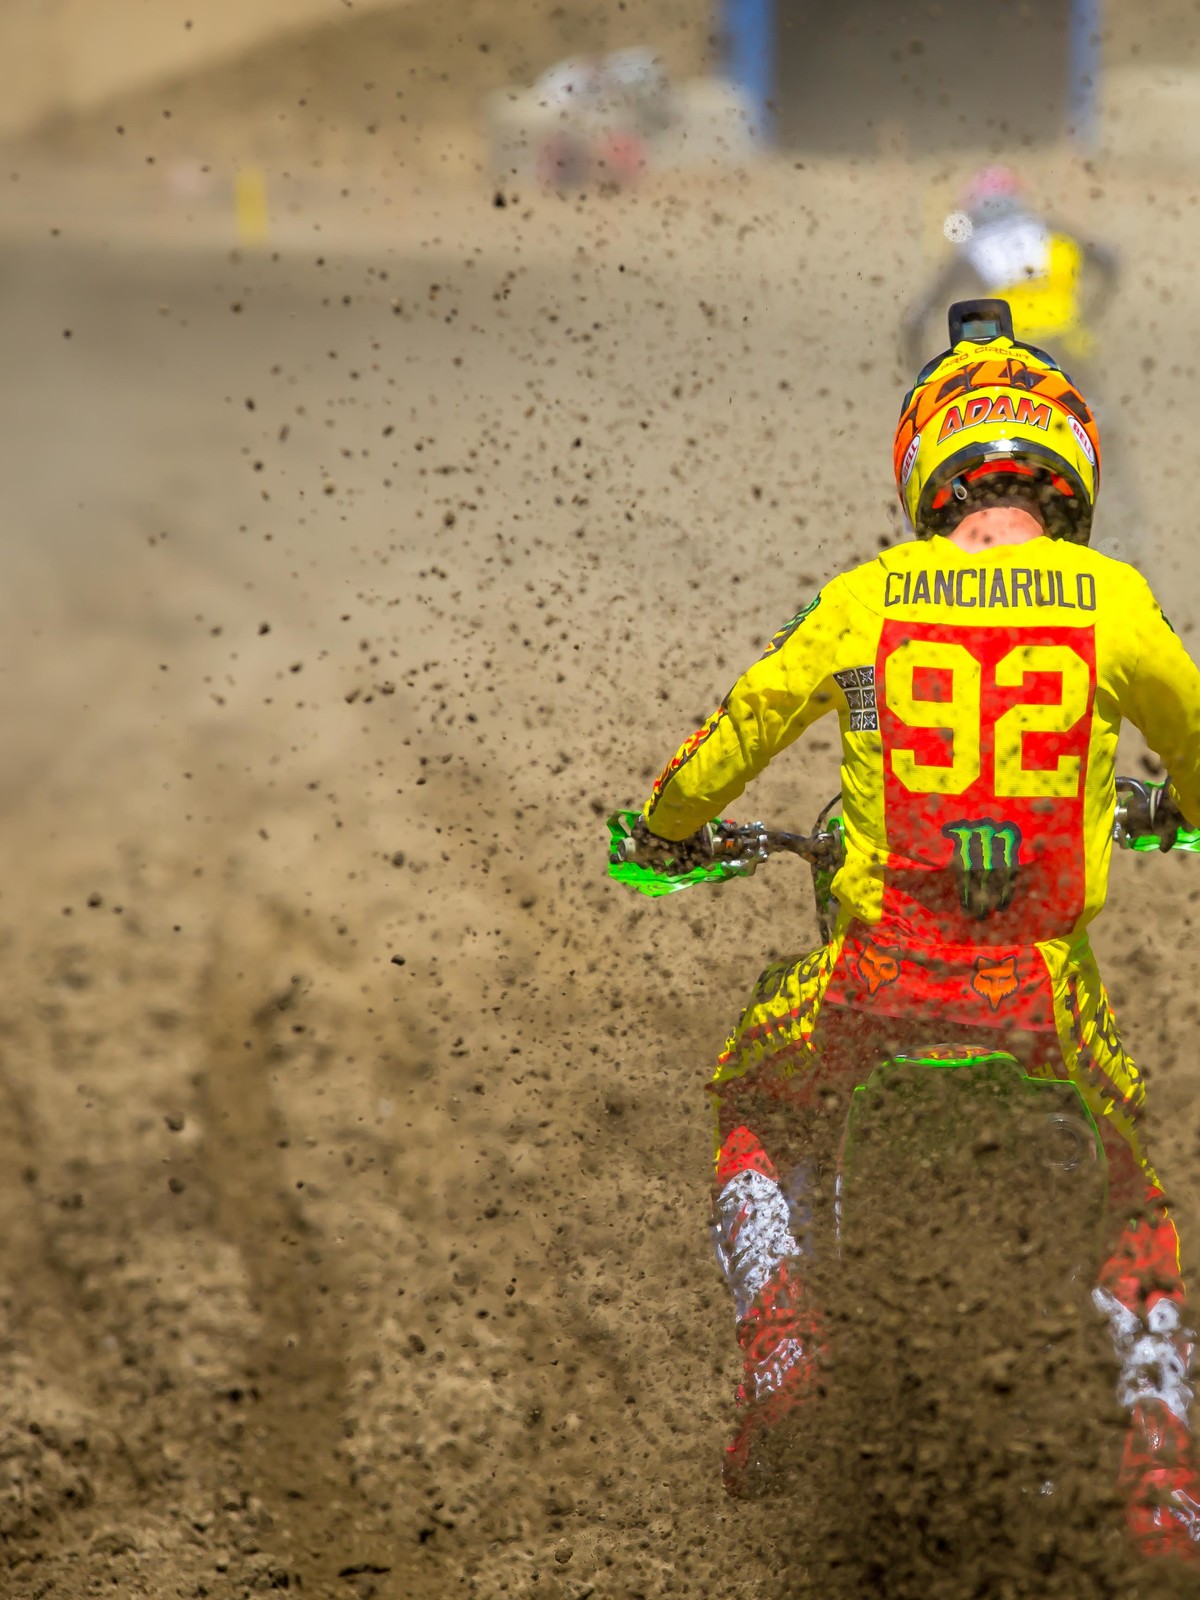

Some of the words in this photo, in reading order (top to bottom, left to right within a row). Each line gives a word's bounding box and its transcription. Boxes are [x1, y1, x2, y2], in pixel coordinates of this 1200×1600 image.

[940, 353, 969, 371] PRO
[974, 346, 1031, 360] CIRCUIT
[937, 396, 1052, 445] ADAM
[1073, 422, 1092, 459] BELL
[884, 568, 1096, 611] CIANCIARULO
[885, 640, 1090, 797] 92
